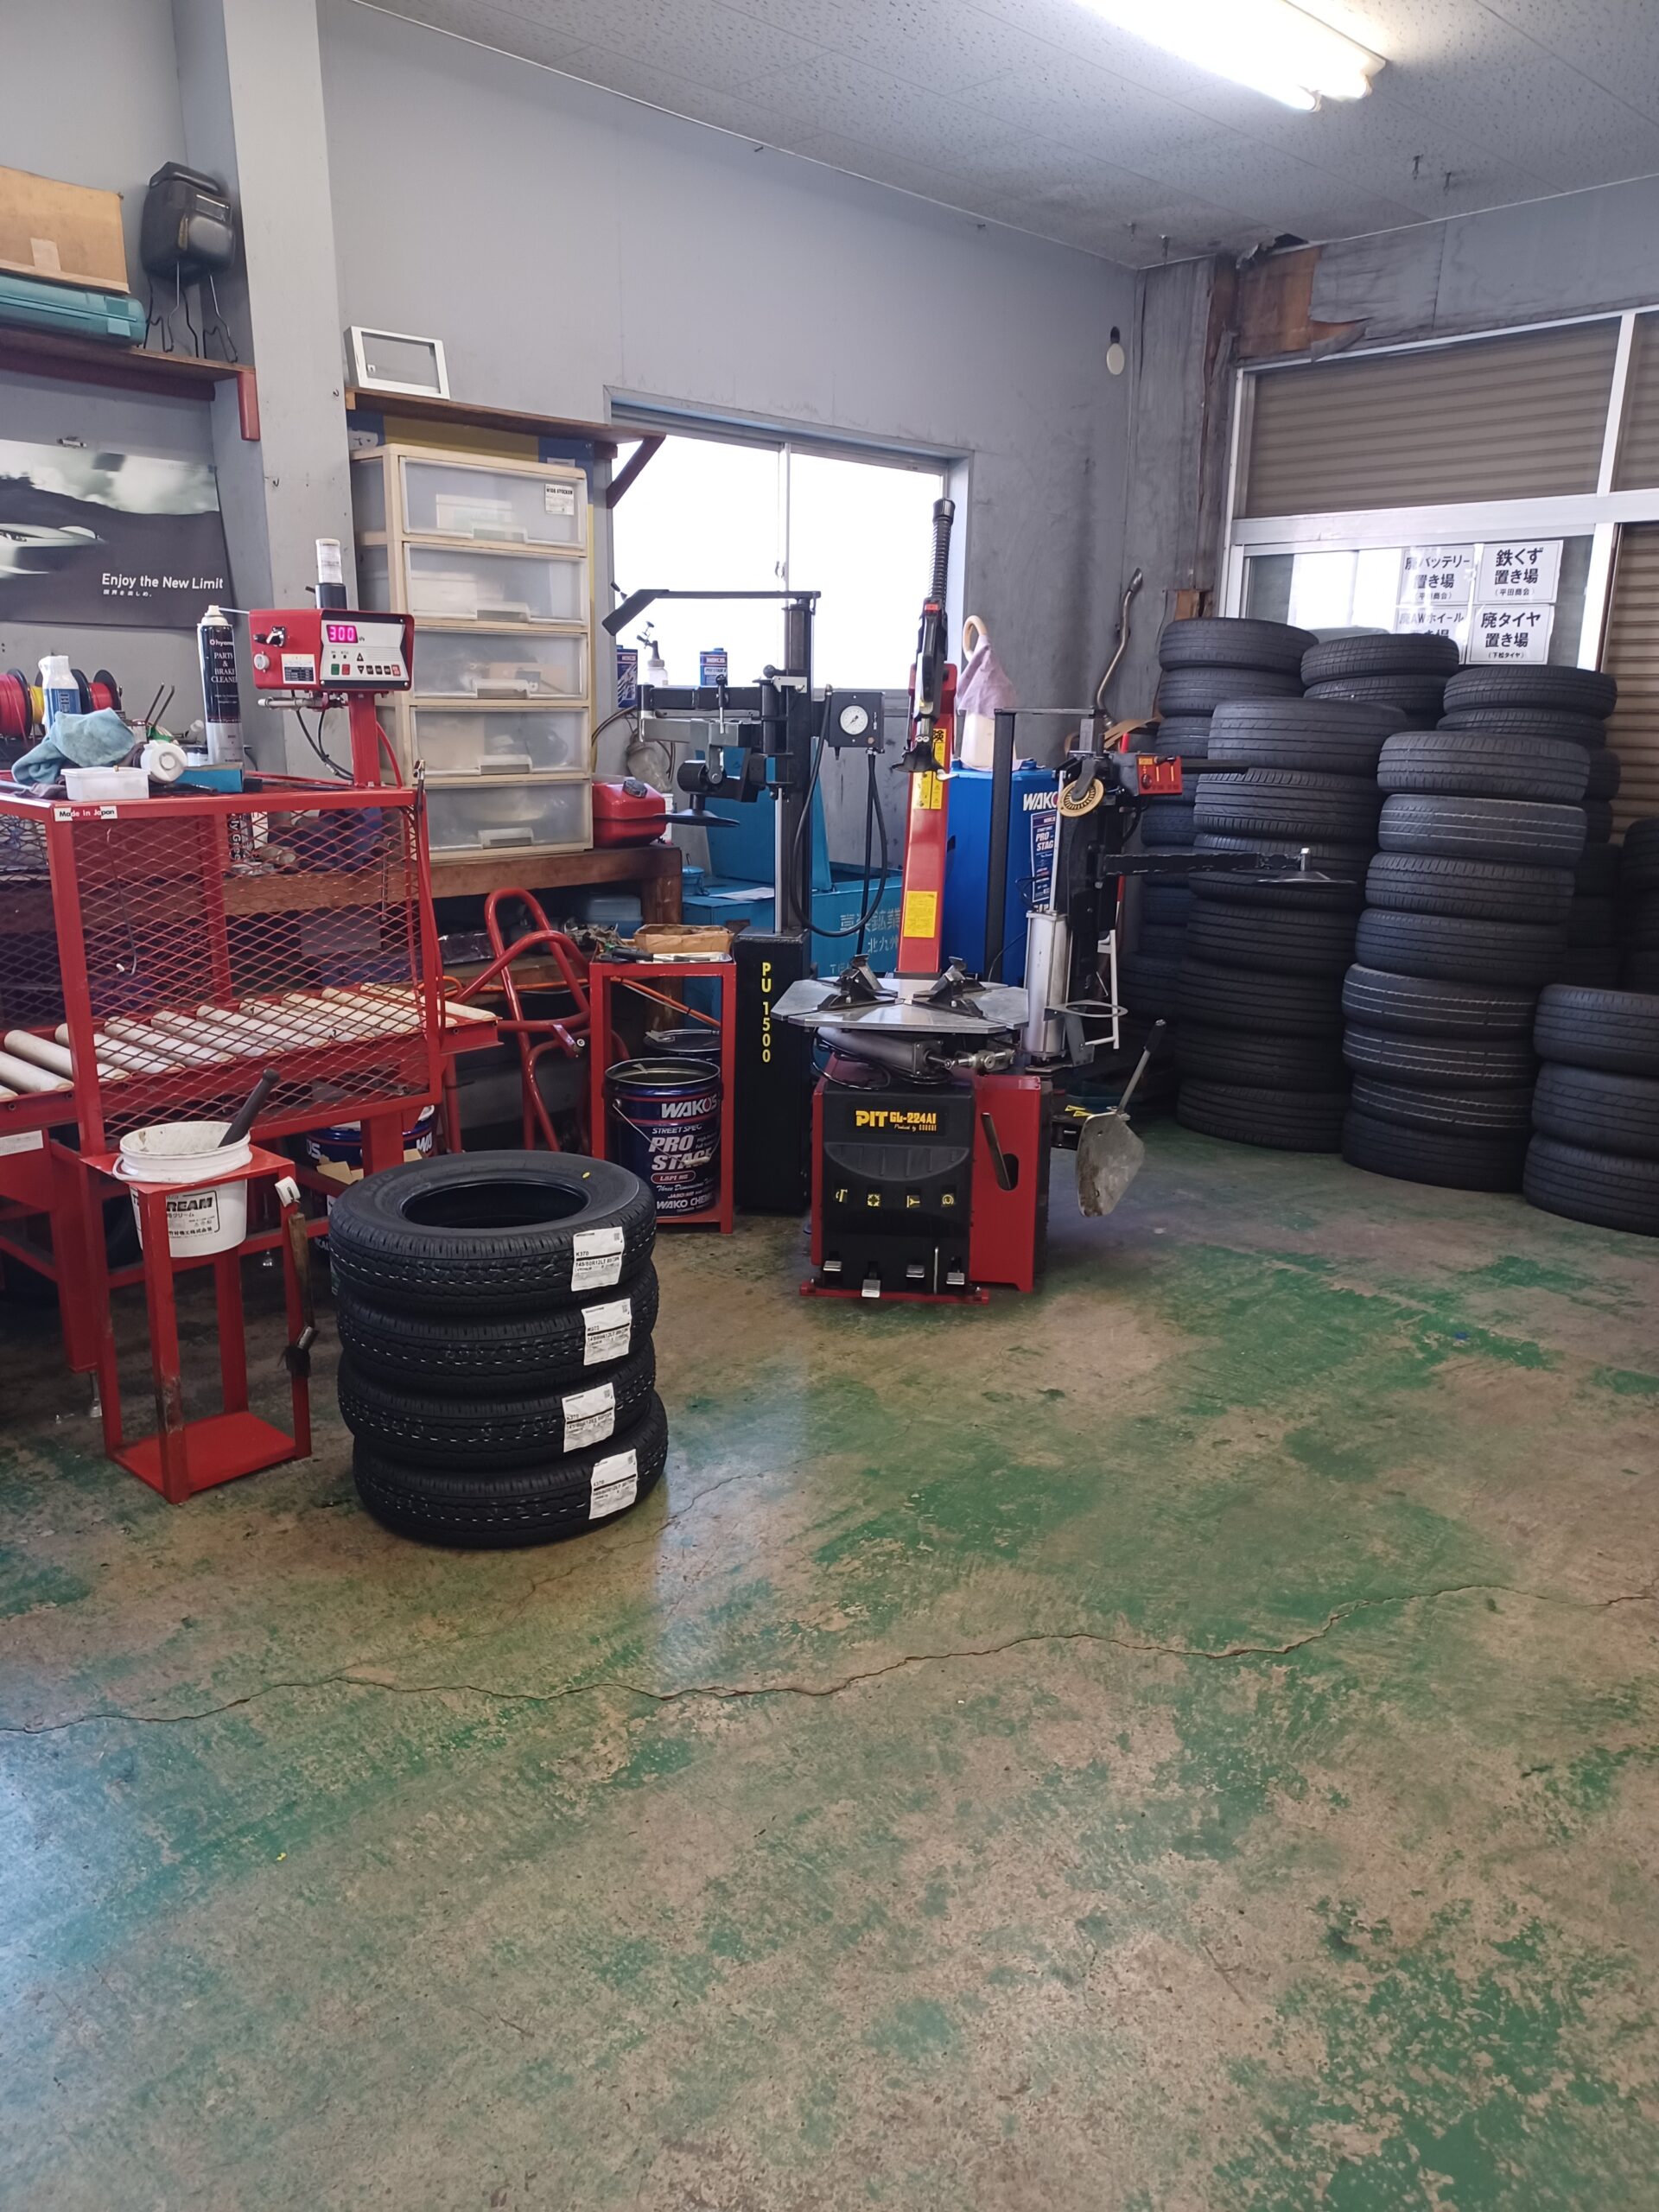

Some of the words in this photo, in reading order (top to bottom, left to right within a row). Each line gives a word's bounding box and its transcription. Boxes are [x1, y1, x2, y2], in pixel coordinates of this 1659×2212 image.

[1496, 547, 1543, 567] 鉄くず
[102, 573, 137, 588] Enjoy
[140, 575, 159, 588] the
[162, 576, 189, 588] New
[192, 577, 224, 589] Limit
[1416, 573, 1455, 589] 置き場
[1495, 569, 1539, 585] 置き場
[1481, 612, 1541, 628] 廃タイヤ
[329, 626, 355, 641] 300
[1485, 632, 1529, 648] 置き場
[93, 809, 115, 817] Japan
[1035, 832, 1050, 842] PRO
[761, 962, 772, 993] PU
[762, 1001, 771, 1063] 1500
[855, 1110, 888, 1127] PIT
[649, 1135, 695, 1154] PRO
[657, 1199, 689, 1210] WAKO
